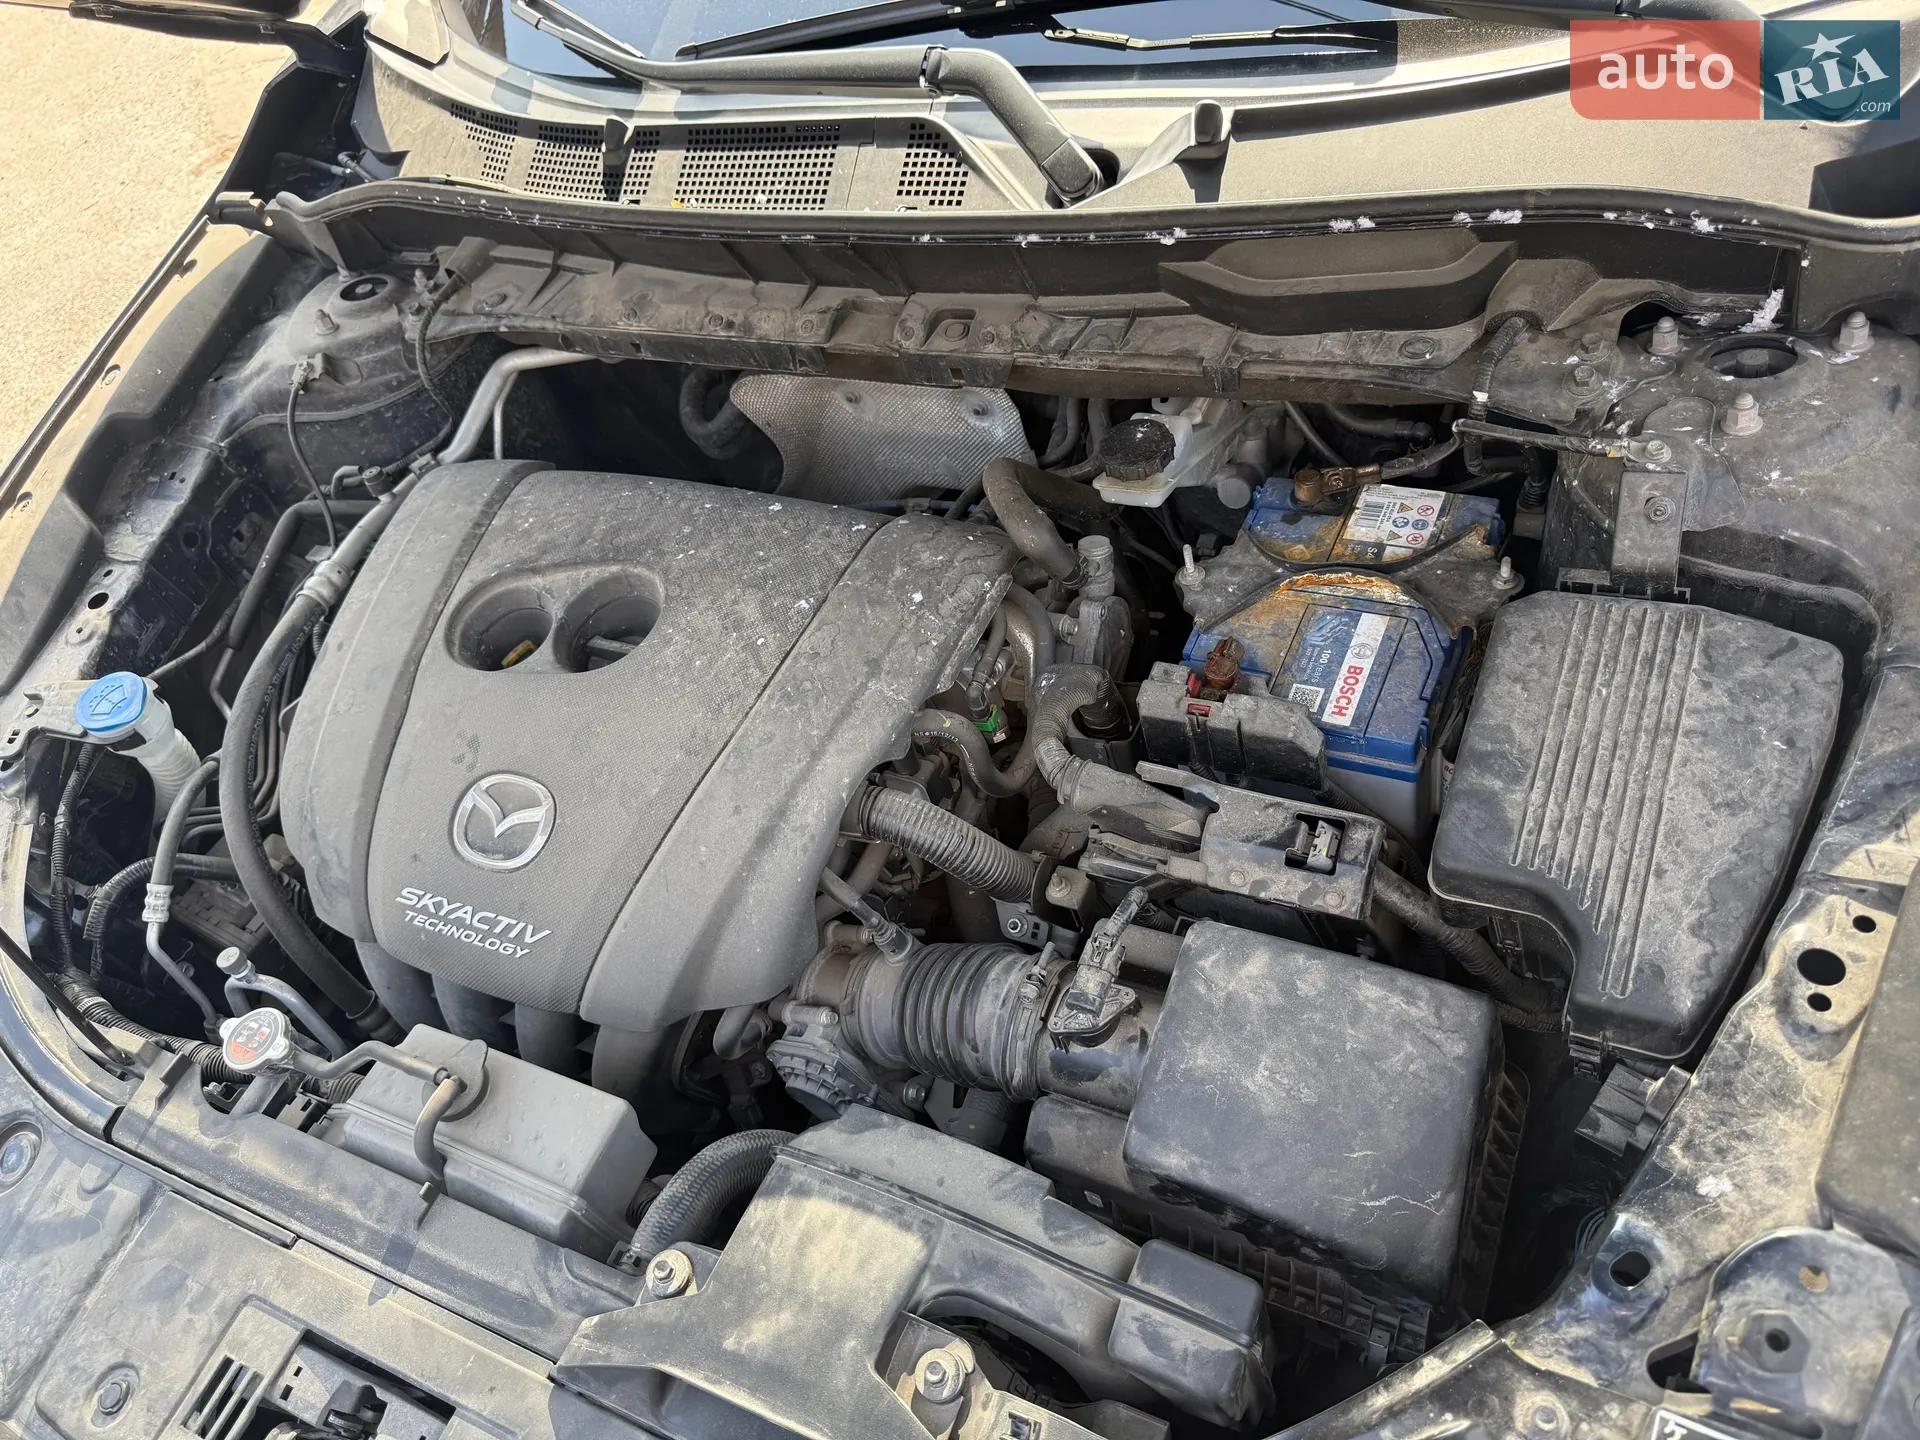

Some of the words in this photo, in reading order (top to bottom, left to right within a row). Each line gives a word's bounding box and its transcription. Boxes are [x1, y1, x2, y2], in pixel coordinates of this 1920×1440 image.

[1364, 546, 1378, 558] S4
[1311, 663, 1325, 683] Years
[1319, 649, 1331, 664] 100
[1331, 664, 1364, 717] BOSCH
[396, 887, 552, 944] SKYACTIV
[403, 910, 531, 958] TECHNOLOGY
